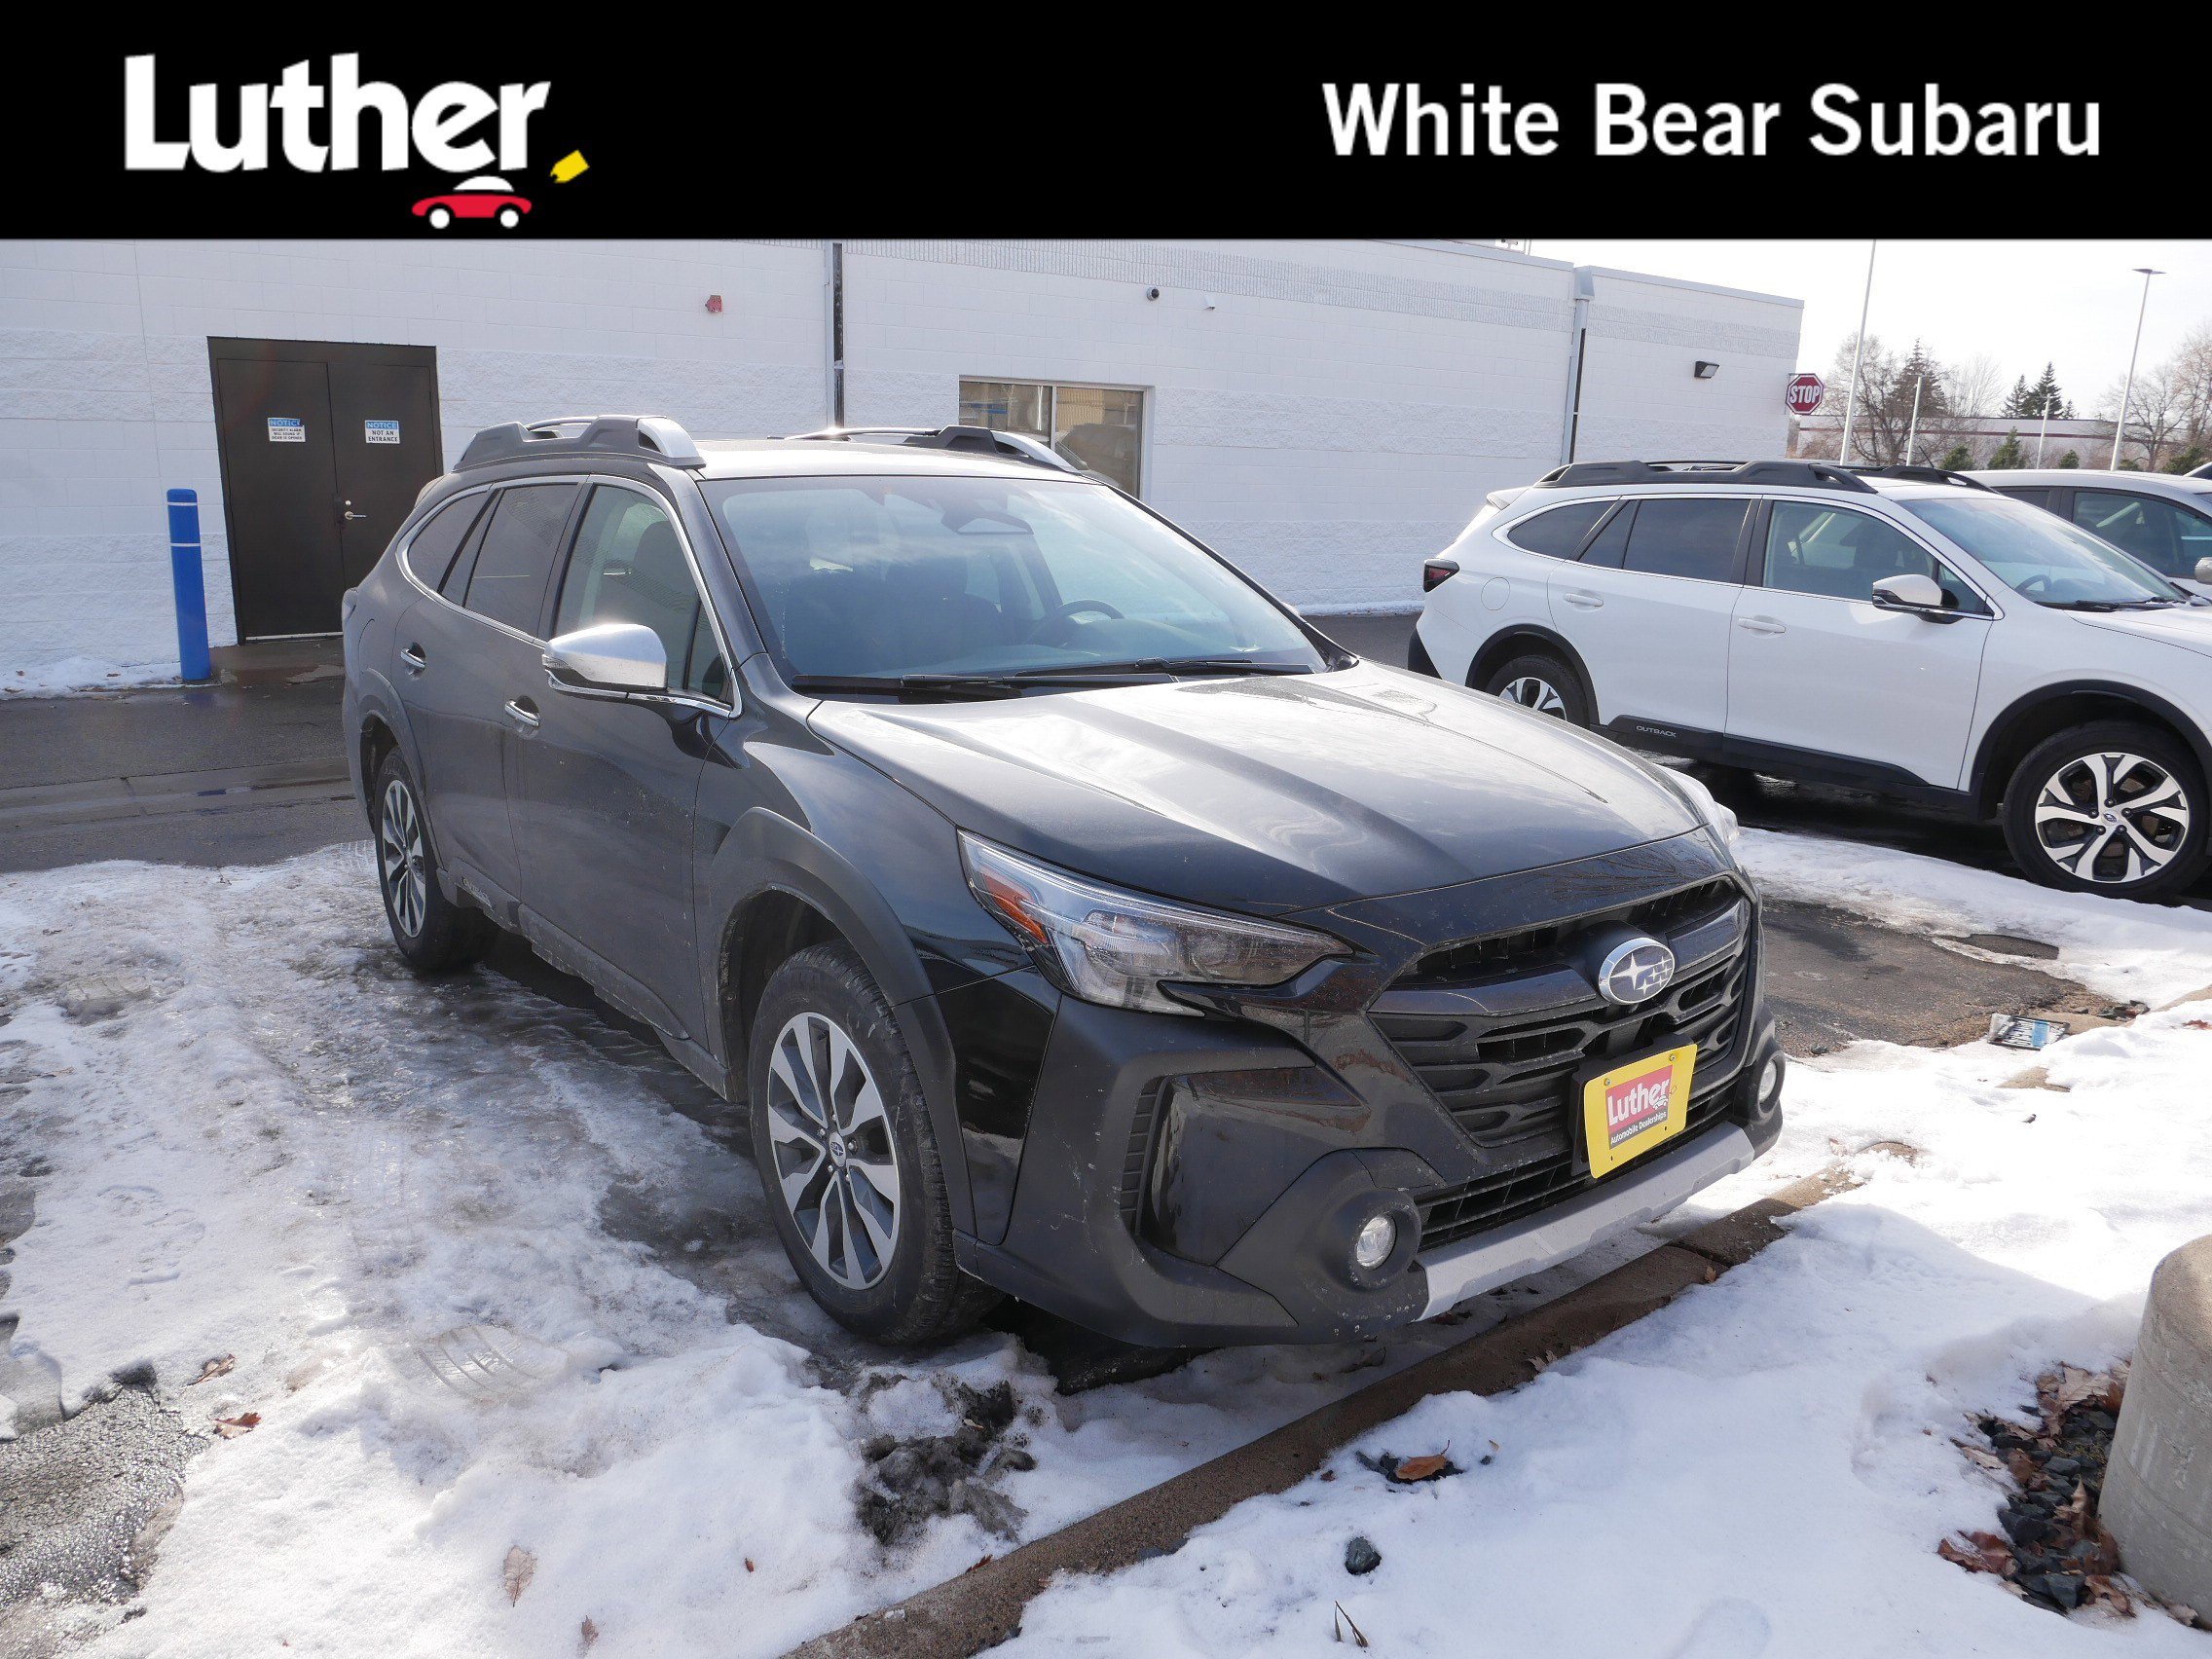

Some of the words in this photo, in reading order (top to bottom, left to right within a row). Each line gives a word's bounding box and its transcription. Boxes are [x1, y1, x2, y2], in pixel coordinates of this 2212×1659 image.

[1789, 385, 1821, 404] STOP
[1636, 725, 1677, 738] OUTBACK
[1607, 1079, 1671, 1126] Luther
[1610, 1124, 1639, 1145] Automobile
[1639, 1111, 1667, 1130] Dealerships
